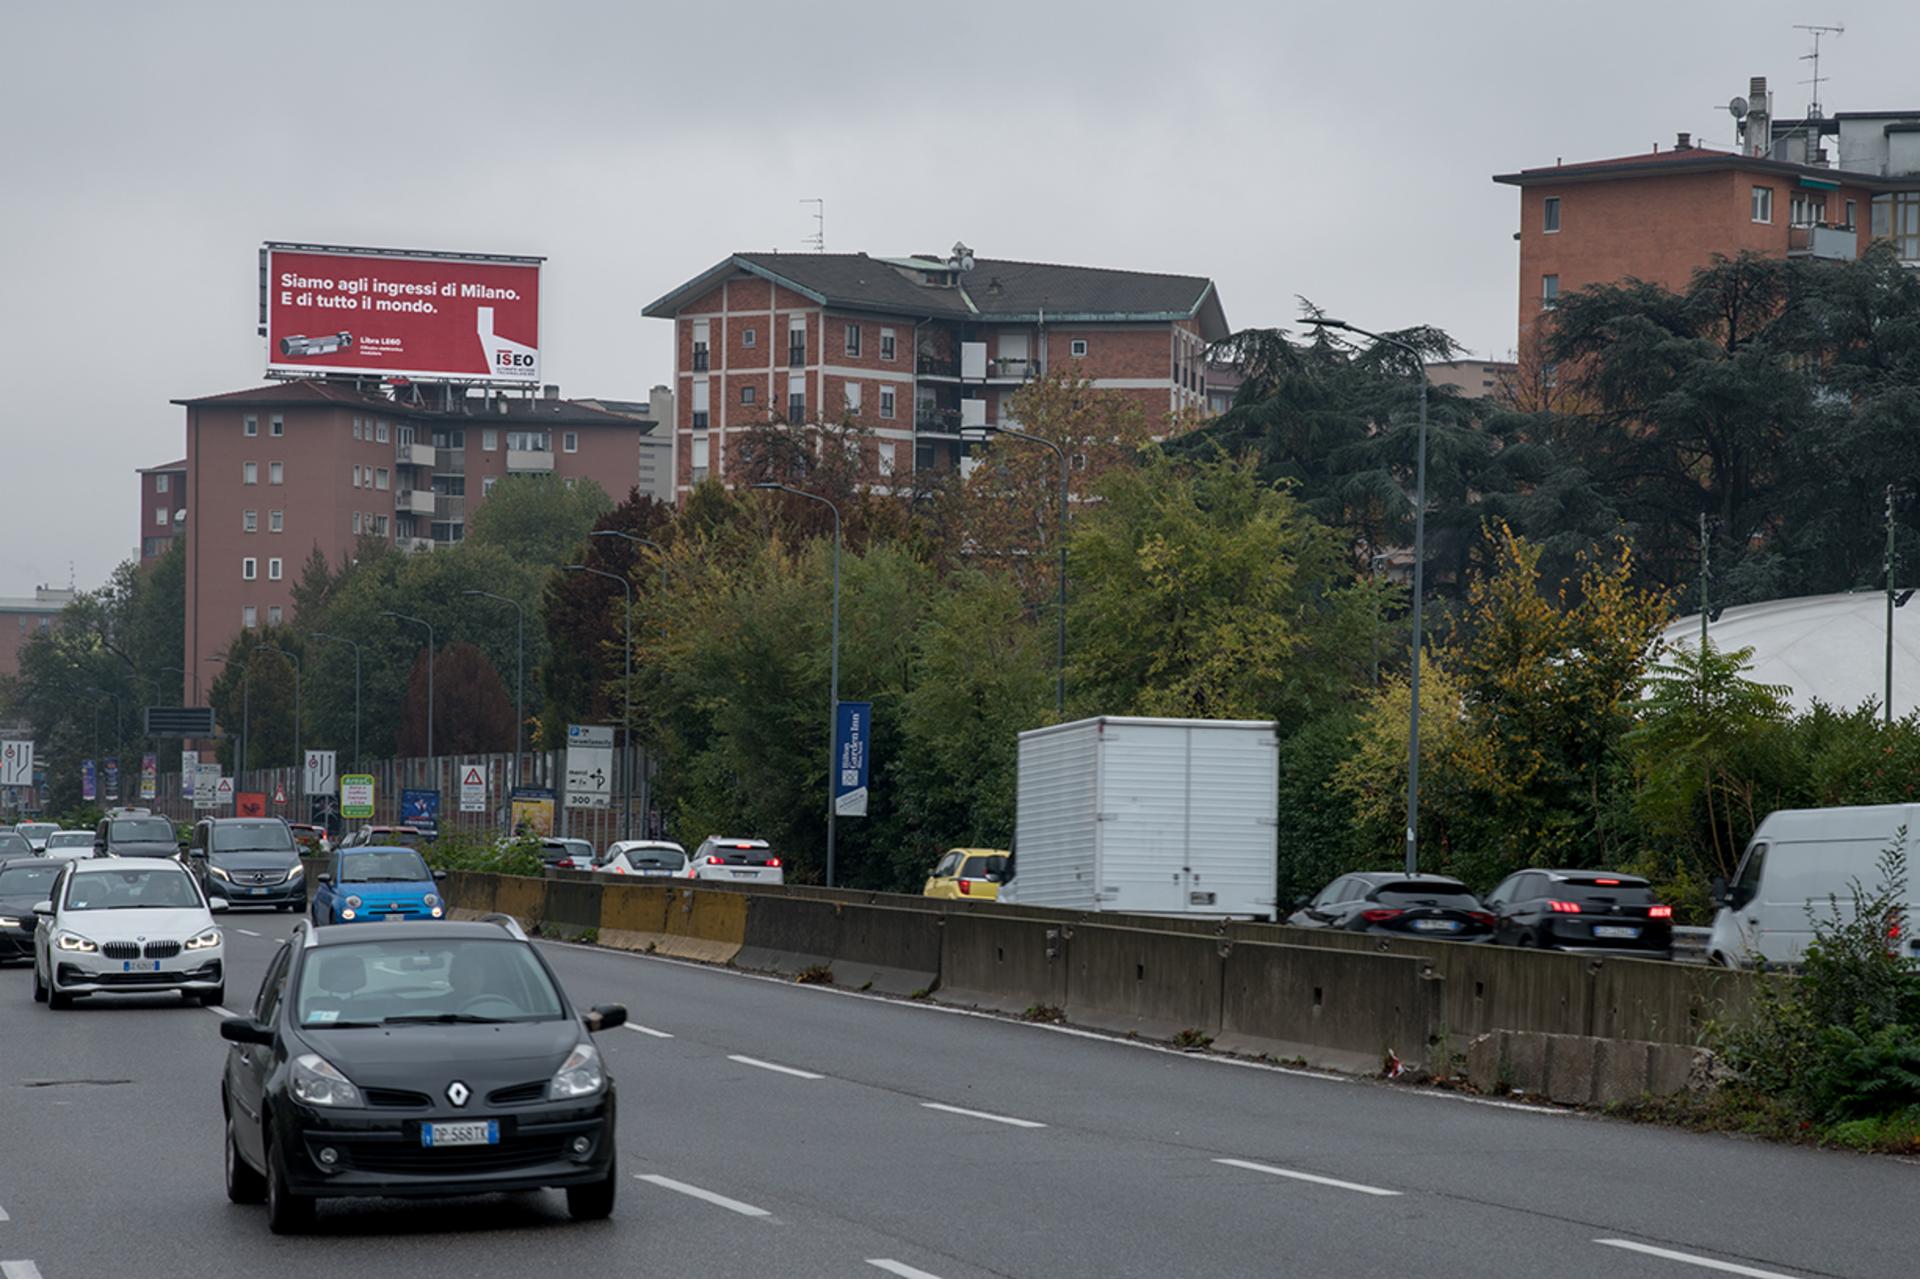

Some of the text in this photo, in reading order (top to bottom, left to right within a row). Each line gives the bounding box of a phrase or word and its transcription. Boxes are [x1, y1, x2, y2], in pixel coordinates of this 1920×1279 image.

[281, 273, 520, 301] Siamo agli ingressi di Milano.
[281, 291, 438, 314] E di tutto il mondo.
[496, 353, 534, 367] ISEO
[849, 713, 860, 769] Garden Inn
[572, 796, 591, 804] 300
